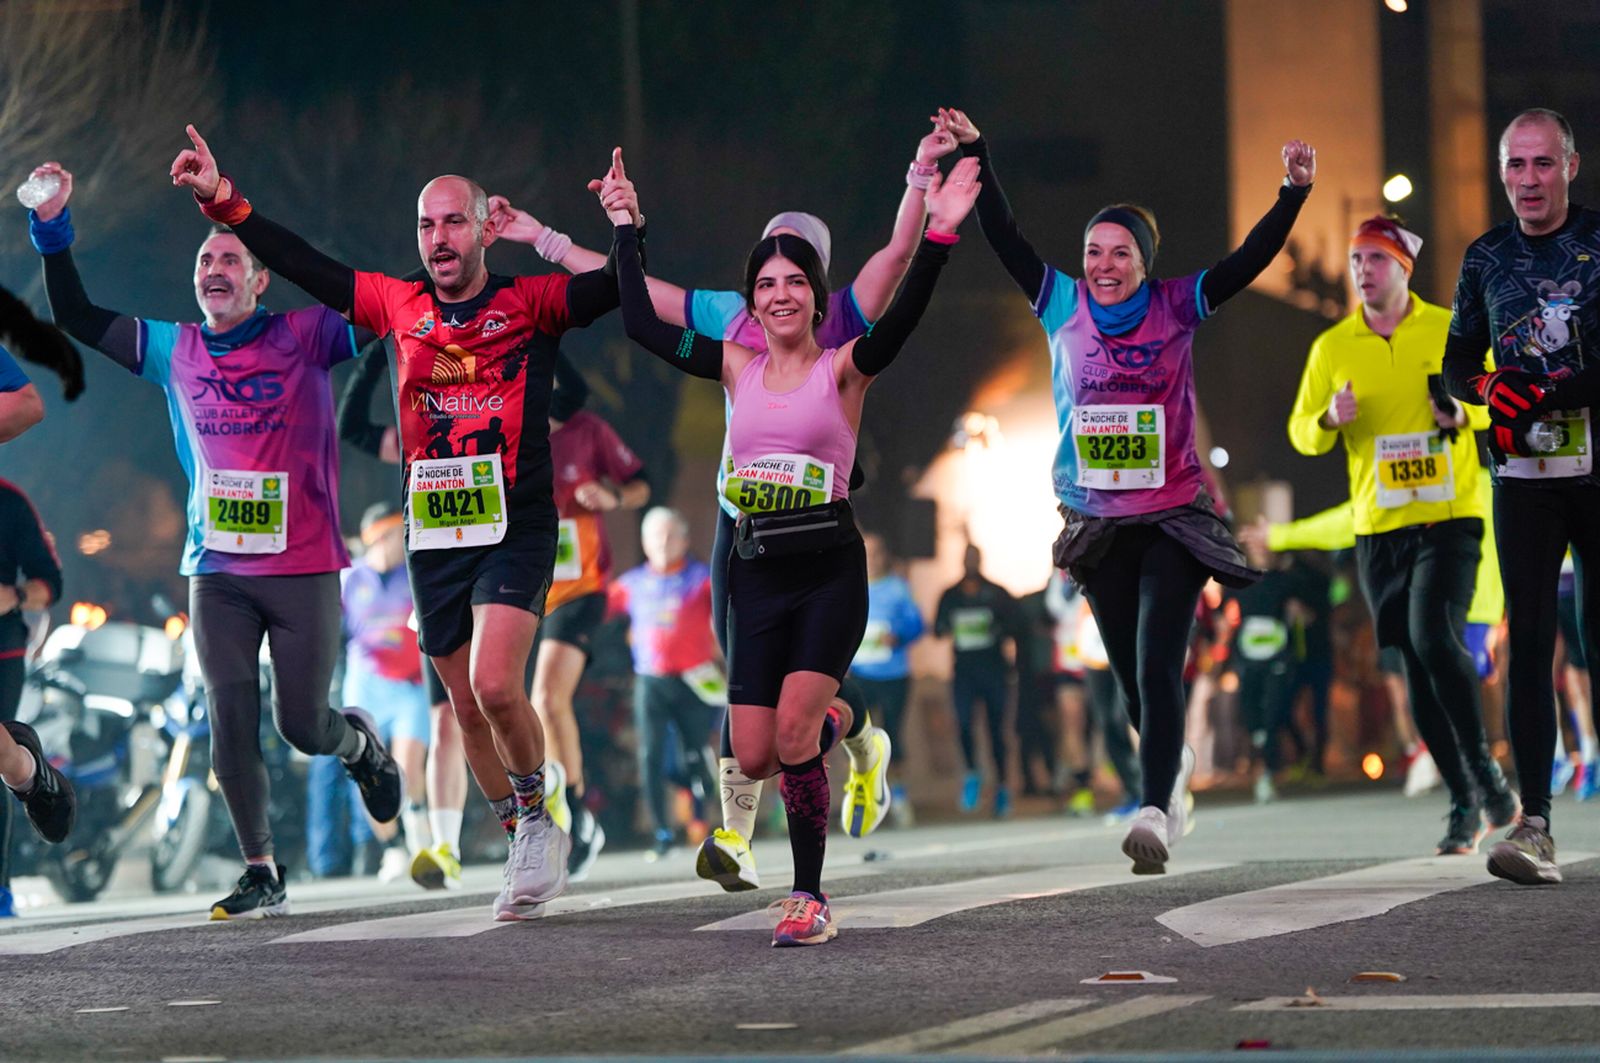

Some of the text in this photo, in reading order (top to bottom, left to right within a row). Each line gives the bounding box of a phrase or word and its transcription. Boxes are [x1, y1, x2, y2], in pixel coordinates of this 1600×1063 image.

[1082, 364, 1108, 378] CLUB
[195, 408, 218, 420] CLUB
[1090, 414, 1115, 423] NOCHE
[1118, 414, 1128, 423] DE
[1081, 425, 1097, 434] SAN
[1088, 435, 1147, 460] 3233
[425, 470, 451, 479] NOCHE
[453, 468, 463, 477] DE
[751, 461, 796, 473] NOCHE DE
[1390, 457, 1437, 482] 1338
[417, 481, 433, 491] SAN
[435, 477, 465, 490] ANTÓN
[737, 470, 758, 478] SAN
[759, 471, 794, 485] ANTÓN
[427, 489, 485, 519] 8421
[218, 500, 270, 526] 2489
